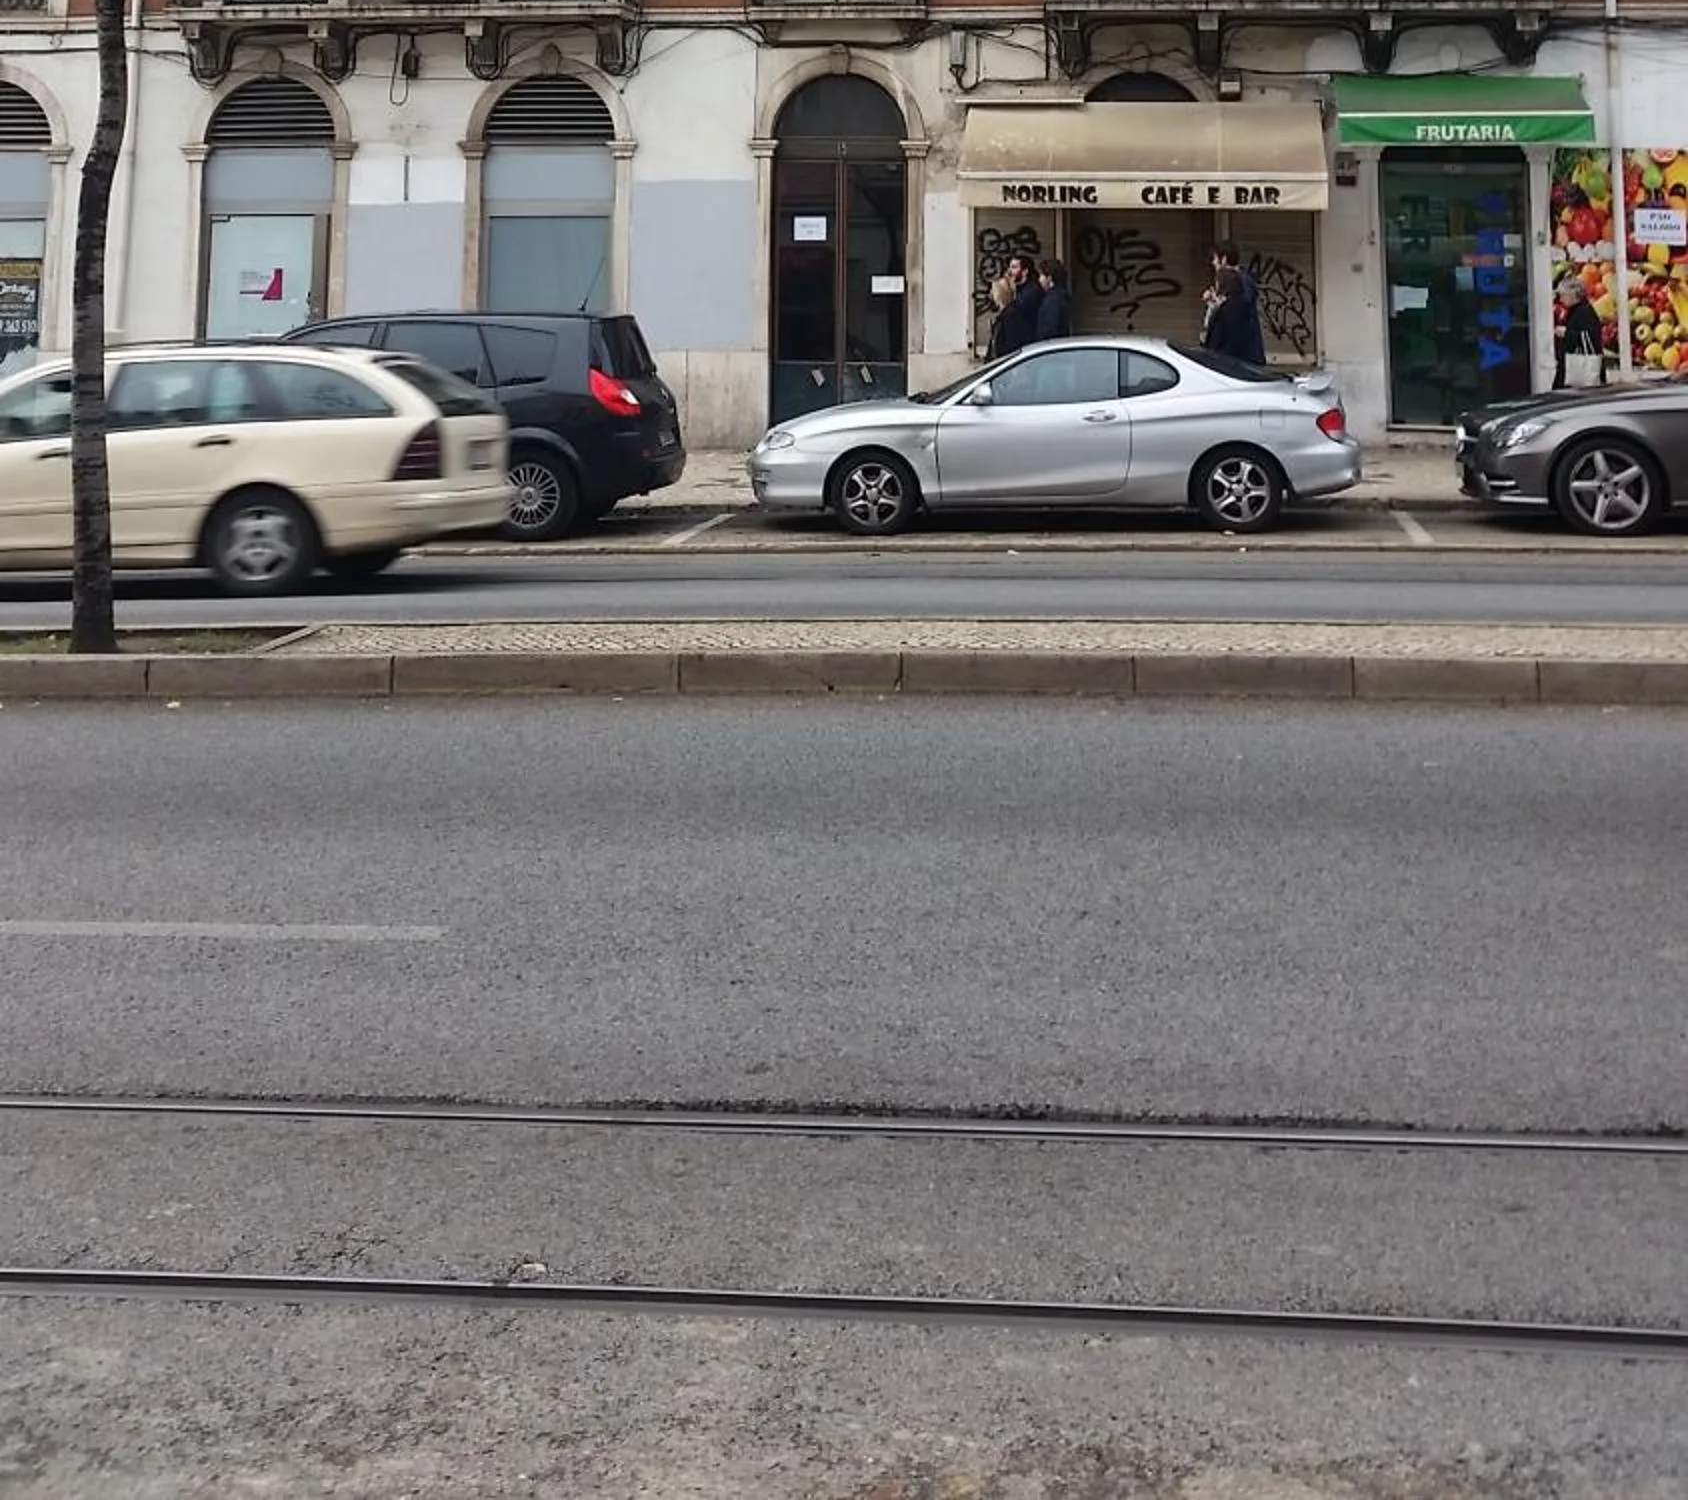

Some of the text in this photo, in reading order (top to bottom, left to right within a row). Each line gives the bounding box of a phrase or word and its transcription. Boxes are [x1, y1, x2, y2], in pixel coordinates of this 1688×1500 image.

[1416, 125, 1515, 141] FRUTARIA
[1002, 181, 1280, 205] NORLING CAFÉ E BAR
